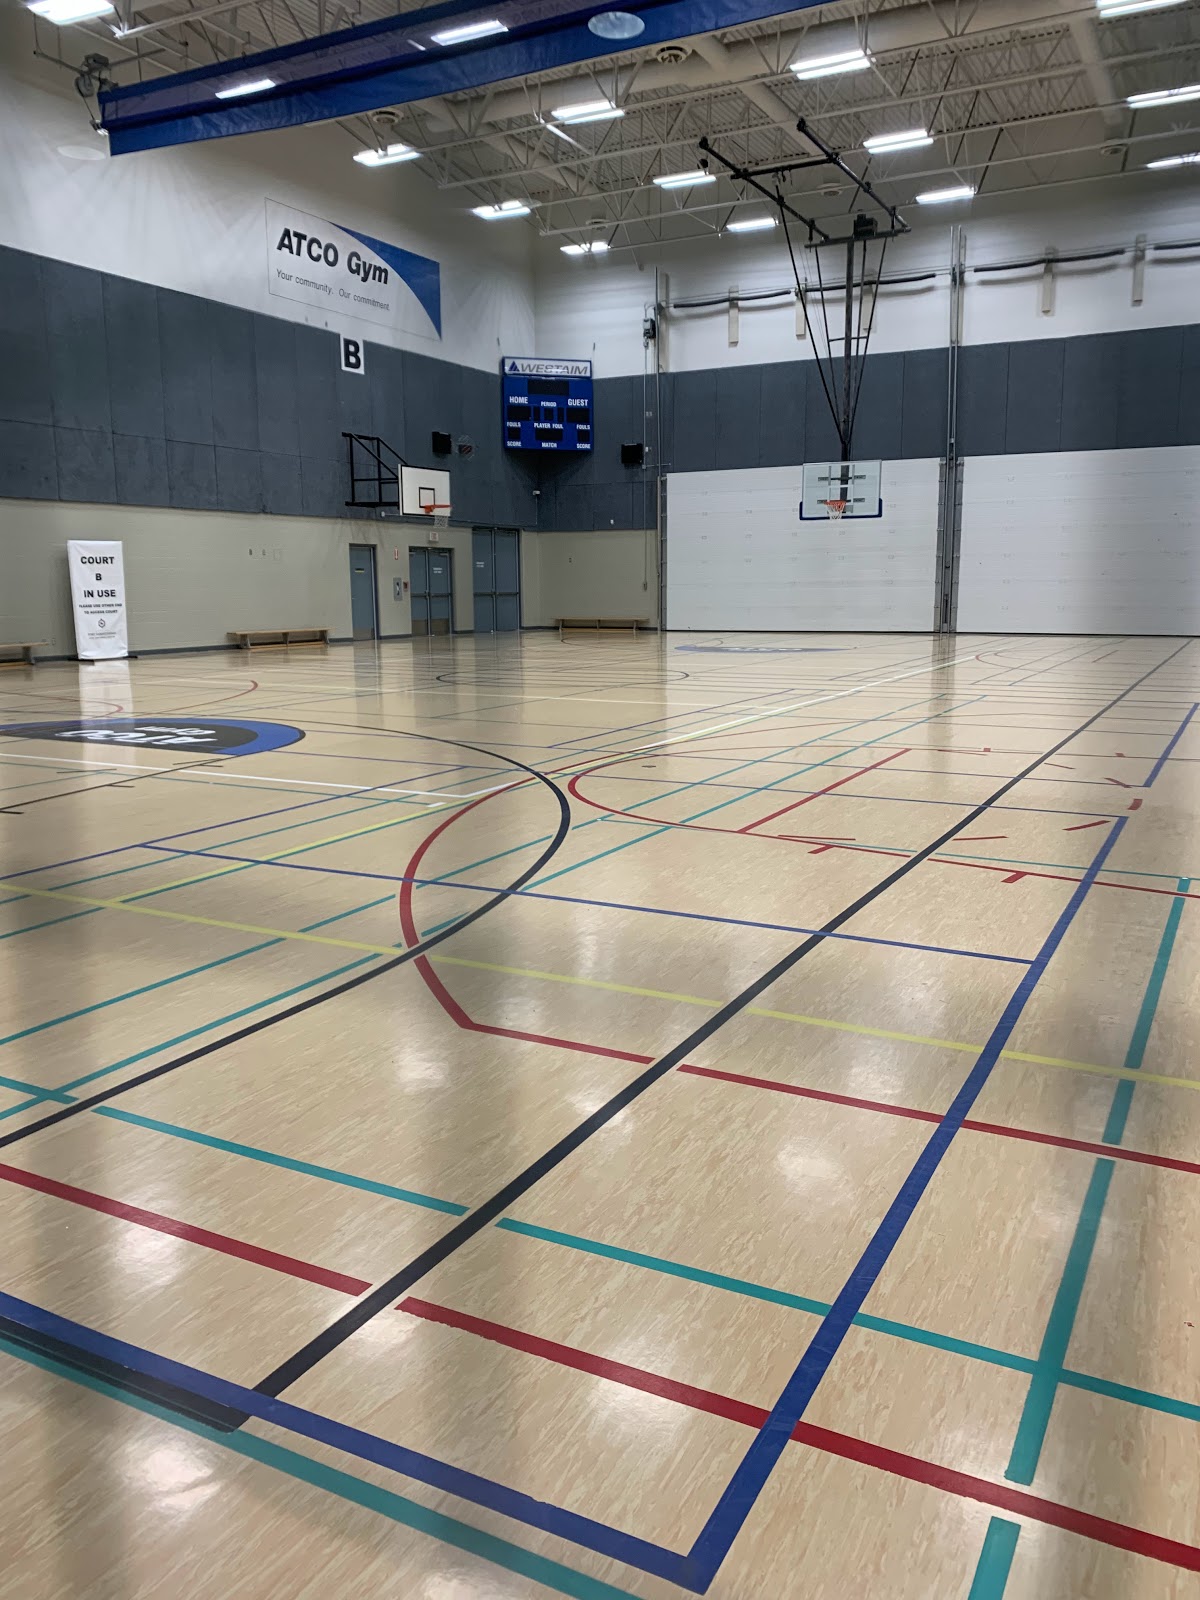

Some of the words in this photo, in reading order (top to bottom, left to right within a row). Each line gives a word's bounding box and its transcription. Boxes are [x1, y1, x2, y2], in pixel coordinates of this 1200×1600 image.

[277, 227, 339, 267] ATCO
[347, 251, 389, 285] Gym
[276, 268, 293, 282] Your
[295, 276, 334, 295] community.
[338, 288, 351, 299] Our
[343, 337, 361, 370] B
[521, 363, 588, 375] WESTAIM
[509, 396, 528, 404] HOME
[568, 398, 589, 406] GUEST
[80, 556, 114, 564] COURT
[95, 573, 102, 581] B
[83, 590, 94, 598] IN
[97, 589, 116, 598] USE
